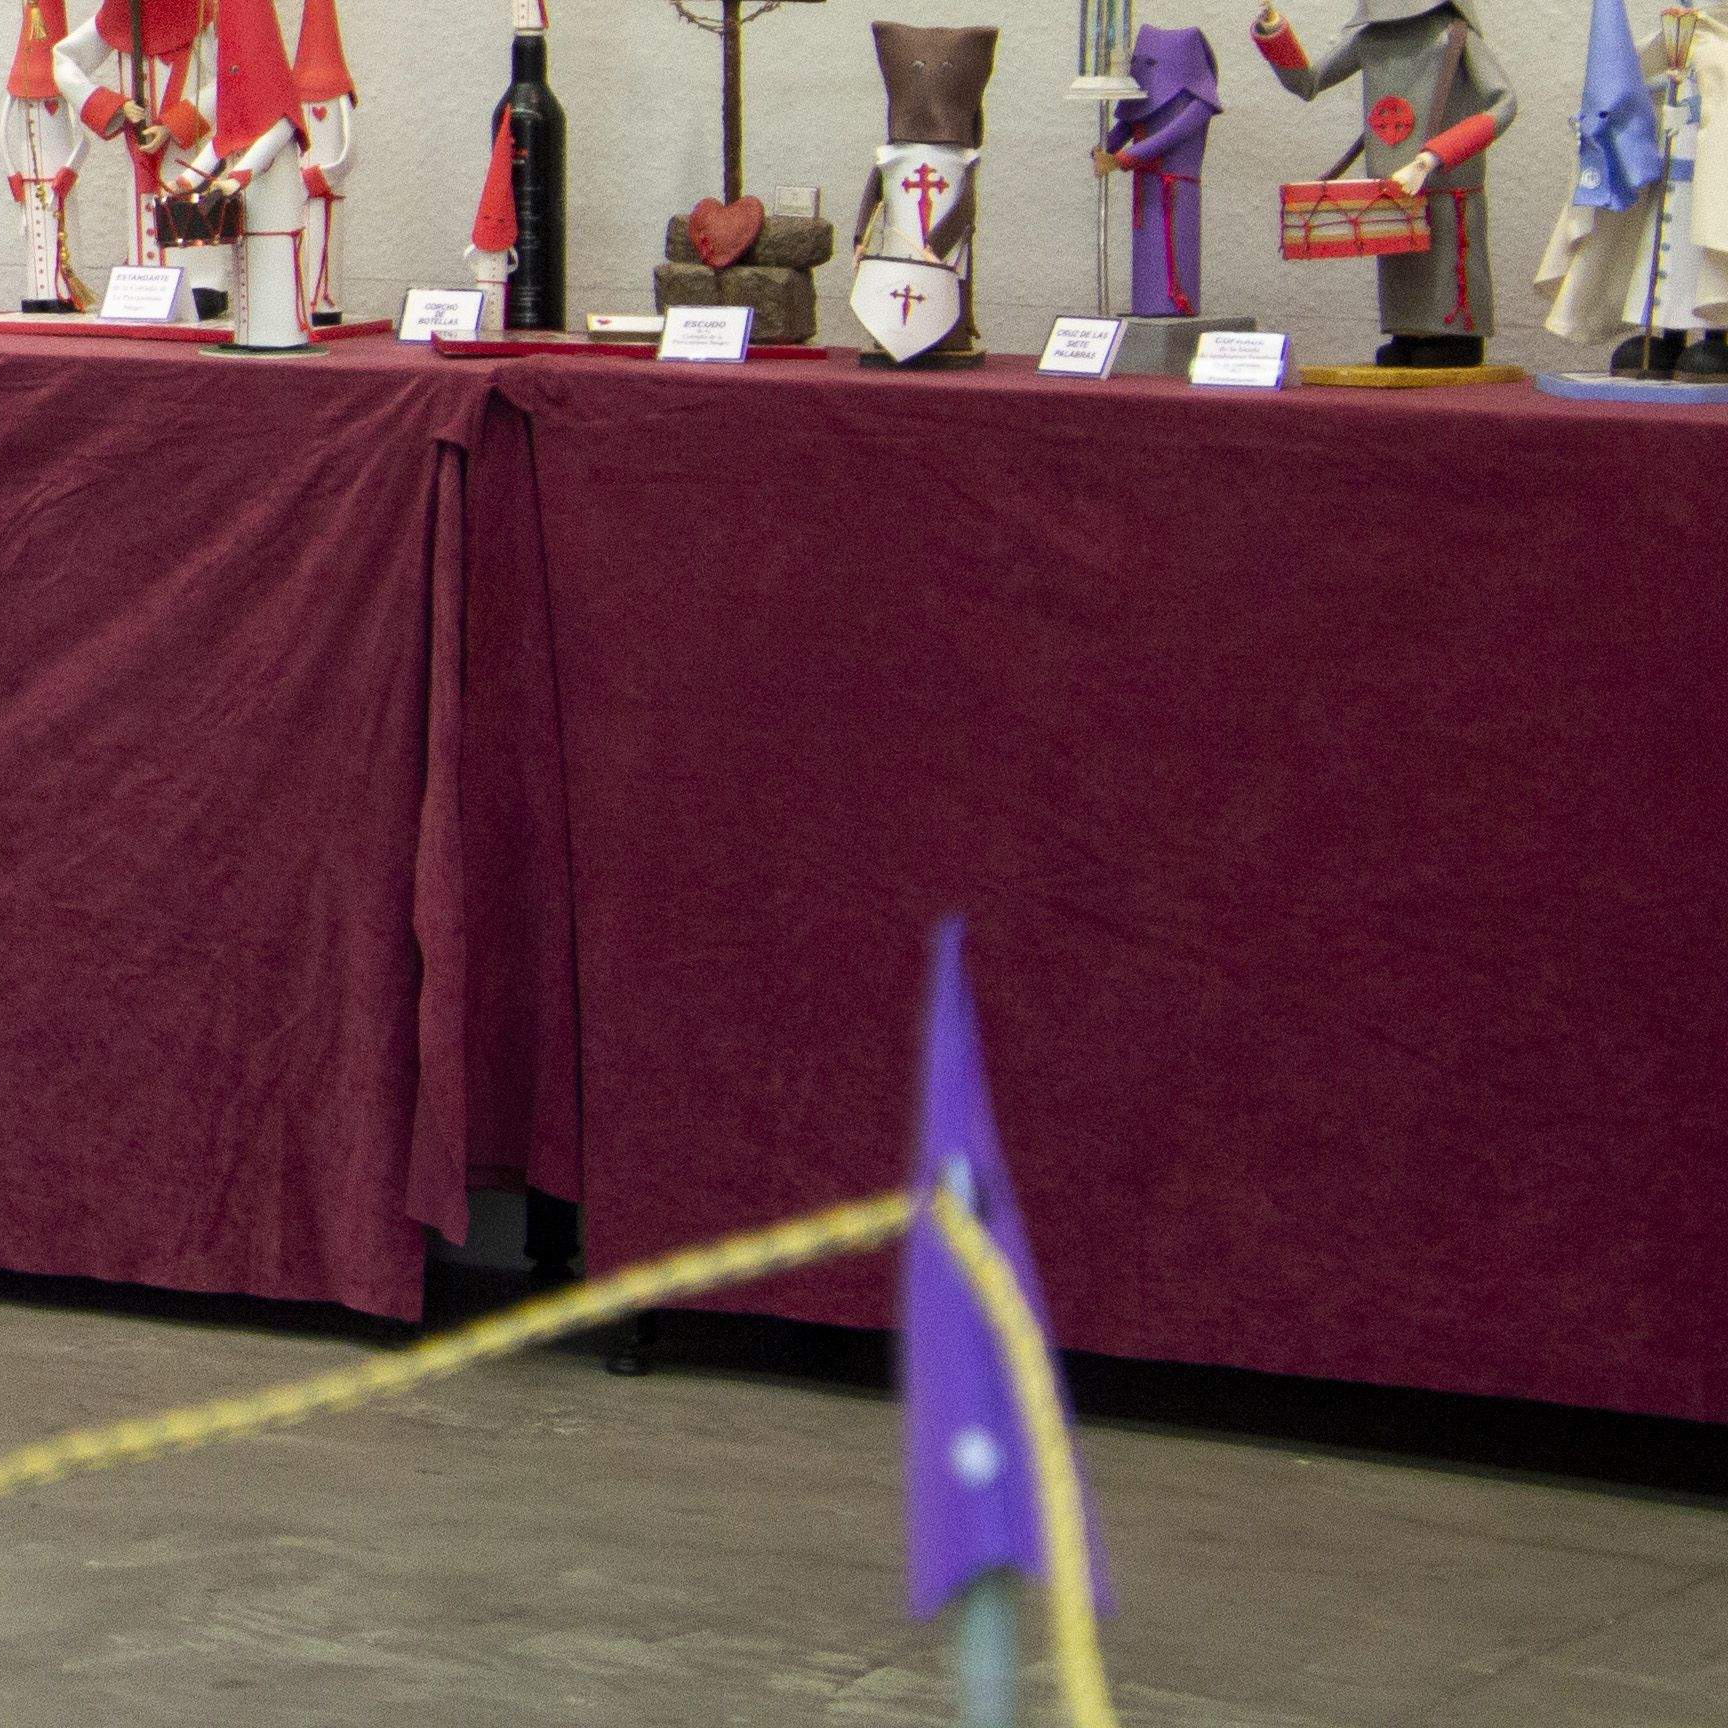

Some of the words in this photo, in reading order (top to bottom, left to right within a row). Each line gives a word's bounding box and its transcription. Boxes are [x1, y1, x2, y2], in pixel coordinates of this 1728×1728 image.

[425, 303, 458, 311] CORCHO
[417, 318, 458, 326] BOTELLAS
[684, 320, 726, 328] ESCUDO
[1056, 329, 1079, 337] CRUZ
[1080, 330, 1090, 338] DE
[1066, 340, 1089, 348] SIETE
[1054, 350, 1096, 359] PALABRAS
